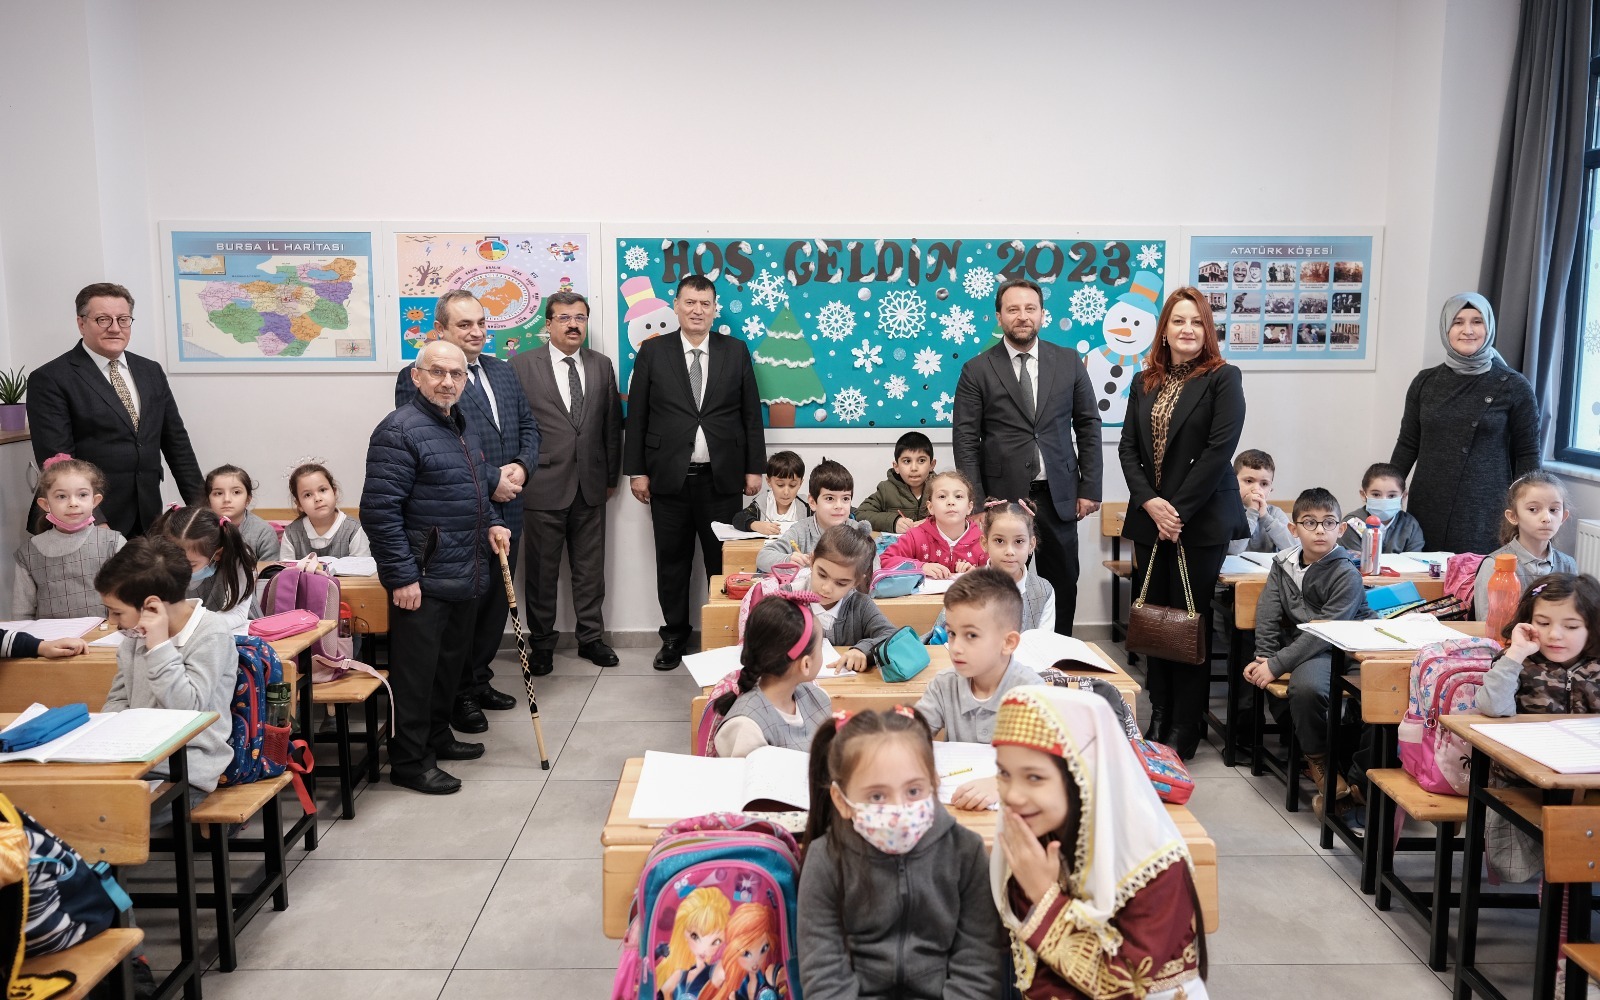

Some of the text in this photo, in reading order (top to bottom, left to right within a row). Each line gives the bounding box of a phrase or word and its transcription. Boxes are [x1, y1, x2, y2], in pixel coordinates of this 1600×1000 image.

[216, 241, 345, 251] BURSA İL HARİTASI
[1230, 245, 1333, 257] ATATÜRK KÖŞESİ
[661, 238, 1131, 292] HOŞ GELDİN 2023
